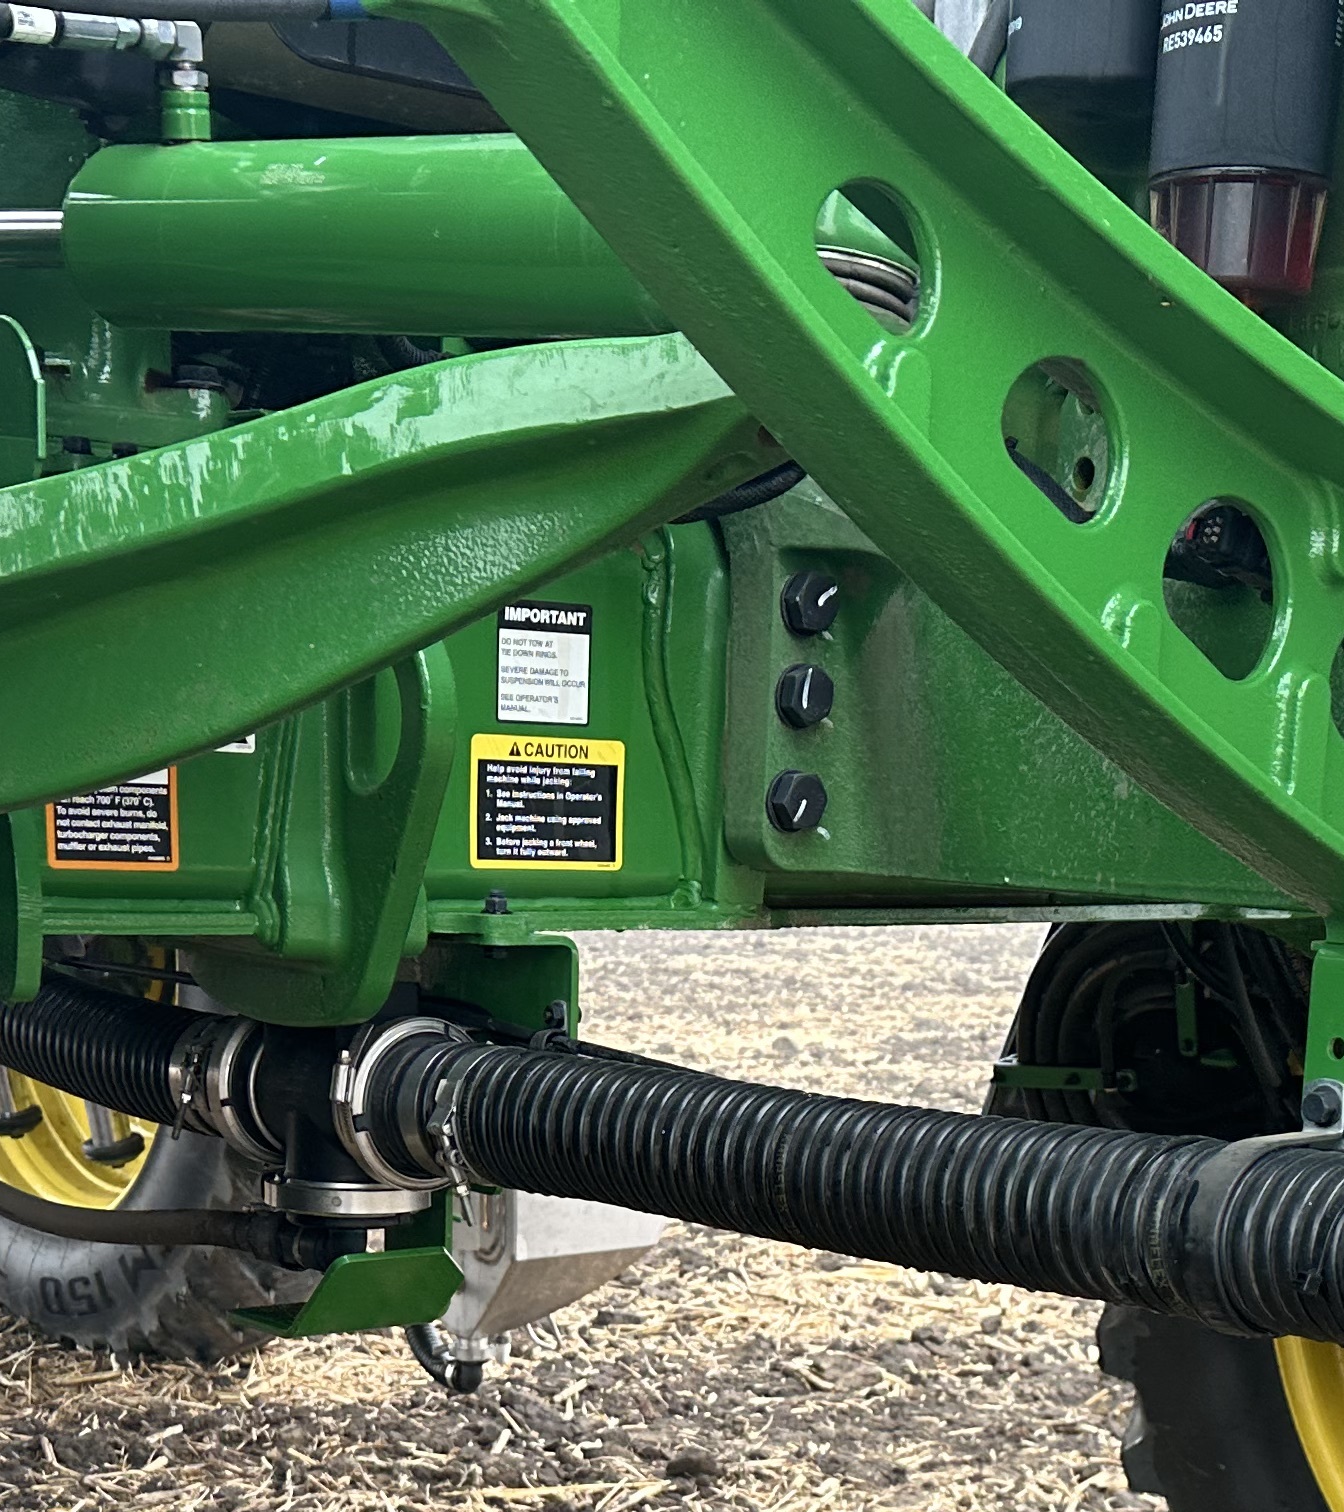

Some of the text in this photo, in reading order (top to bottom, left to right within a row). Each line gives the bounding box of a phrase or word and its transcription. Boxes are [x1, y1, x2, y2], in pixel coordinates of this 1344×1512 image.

[1184, 0, 1239, 20] DEERE
[1163, 24, 1223, 54] RE539465
[504, 606, 587, 626] IMPORTANT
[501, 637, 554, 648] DO NOT TOW AT
[513, 649, 534, 657] DOWN
[501, 666, 569, 677] SEVERE DAMAGE TO
[501, 676, 586, 688] SUSPENSION WILL OCCUR
[501, 693, 559, 704] SEE OPERATOR'S
[524, 742, 589, 759] CAUTION
[486, 763, 596, 778] Help avoid injury from falling
[486, 775, 519, 784] machine
[520, 775, 541, 784] while
[119, 786, 168, 795] components
[485, 789, 603, 802] 1. See instructions in Operator's
[72, 796, 95, 804] reach
[115, 796, 121, 804] F
[56, 805, 157, 818] To avoid severe burns, do
[56, 818, 168, 830] not contact exhaust manifold,
[485, 813, 602, 825] 2. Jack machine using approved
[56, 829, 161, 842] turbocharger components,
[57, 841, 155, 854] muffler or exhaust pipes.
[485, 837, 493, 846] 3.
[496, 837, 520, 846] Before
[521, 838, 548, 848] jacking
[555, 839, 573, 847] front
[520, 848, 536, 857] fully
